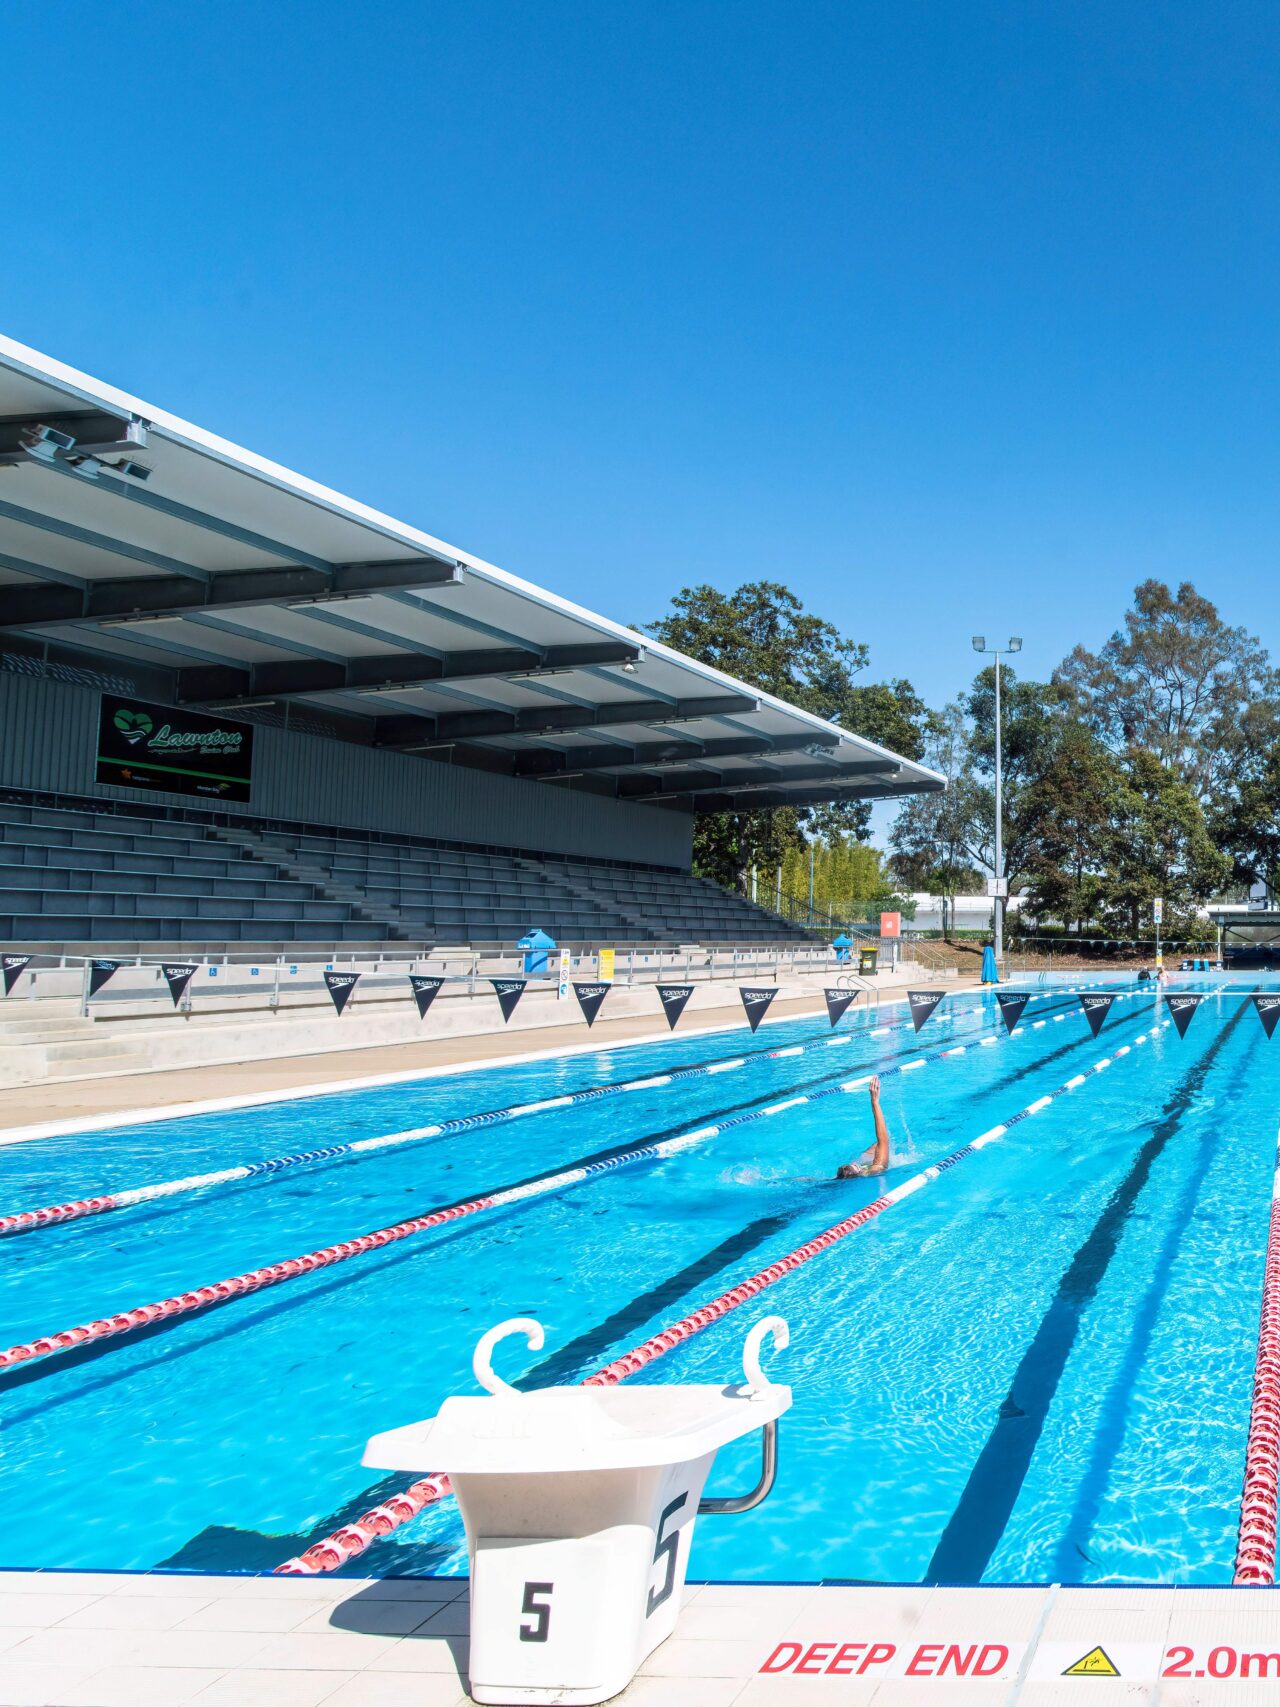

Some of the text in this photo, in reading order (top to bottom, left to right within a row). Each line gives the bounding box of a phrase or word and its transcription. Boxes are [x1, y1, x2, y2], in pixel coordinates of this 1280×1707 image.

[147, 724, 242, 747] Lawnton
[578, 986, 606, 995] speedo
[662, 989, 689, 997] speedo
[828, 990, 855, 998] speedo
[744, 991, 772, 1000] speedo
[912, 994, 939, 1003] speedo
[1084, 998, 1111, 1006] speedo
[1170, 998, 1198, 1006] speedo
[646, 1490, 689, 1619] 5
[519, 1581, 554, 1642] 5
[758, 1642, 1009, 1676] DEEP END
